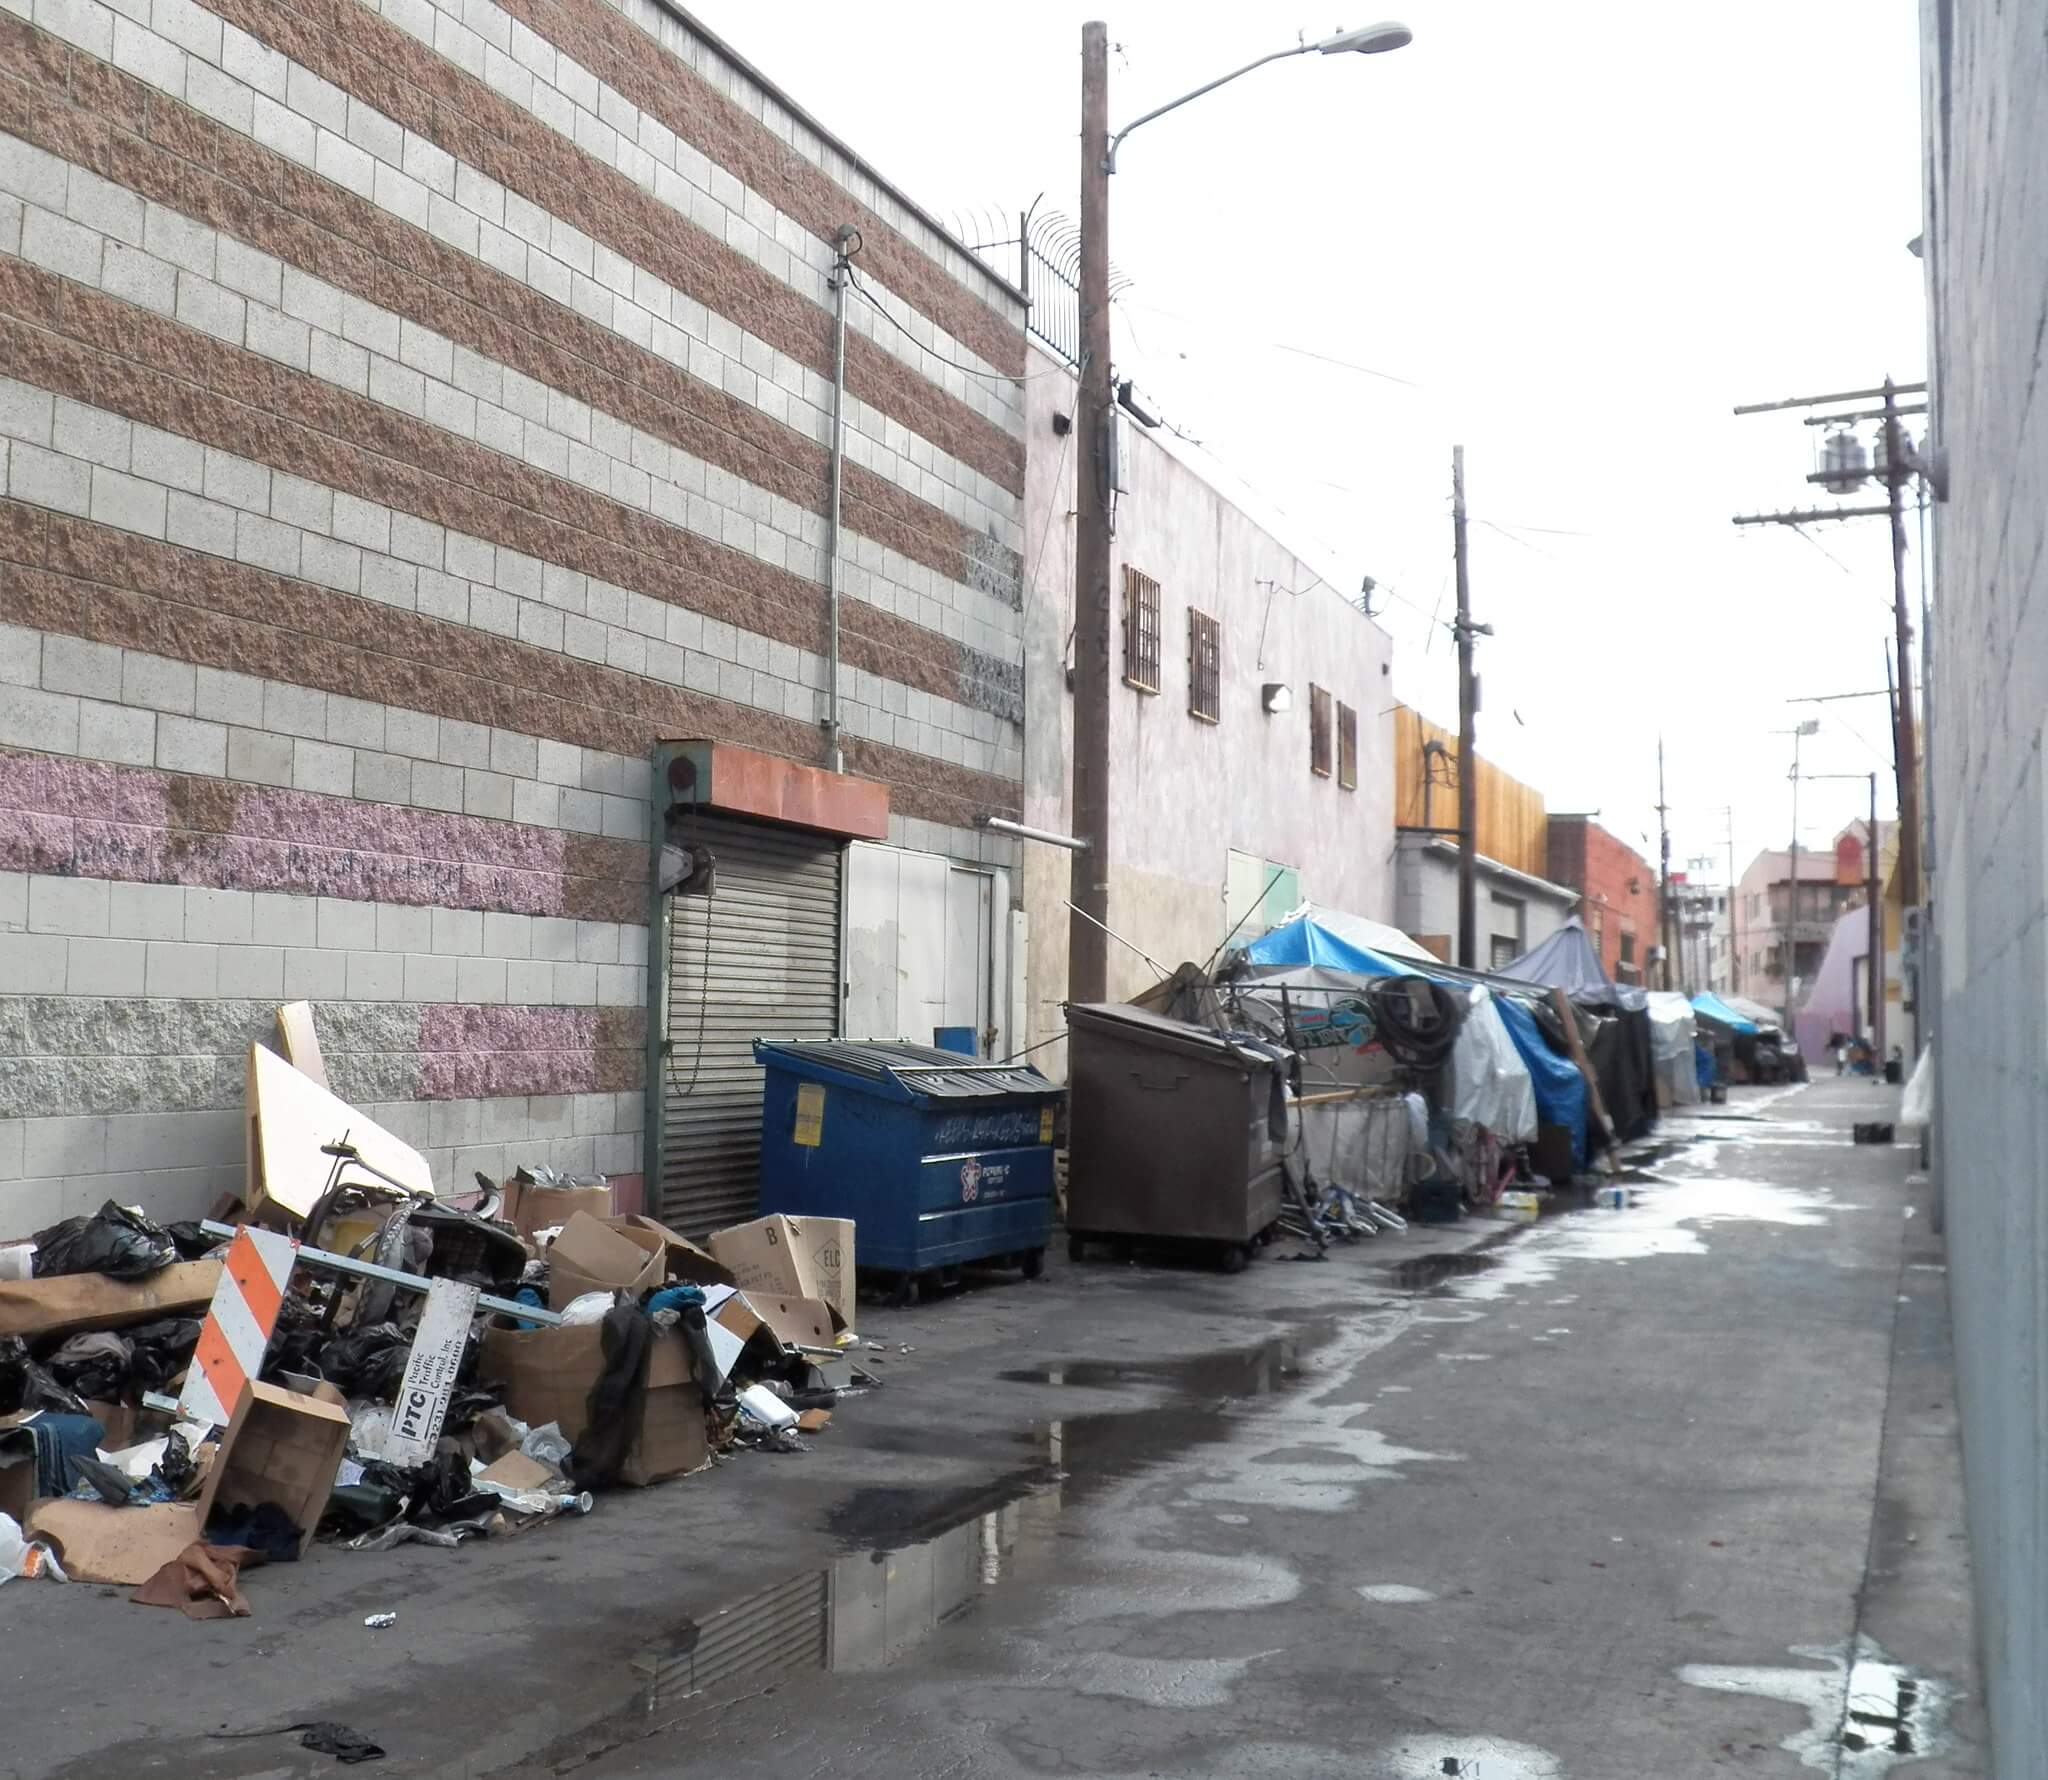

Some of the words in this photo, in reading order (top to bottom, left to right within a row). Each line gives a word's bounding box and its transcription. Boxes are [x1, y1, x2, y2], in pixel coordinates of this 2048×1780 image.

[765, 1227, 778, 1246] B
[408, 1351, 424, 1383] Pacific
[418, 1354, 436, 1385] Traffic
[402, 1392, 426, 1437] PTC
